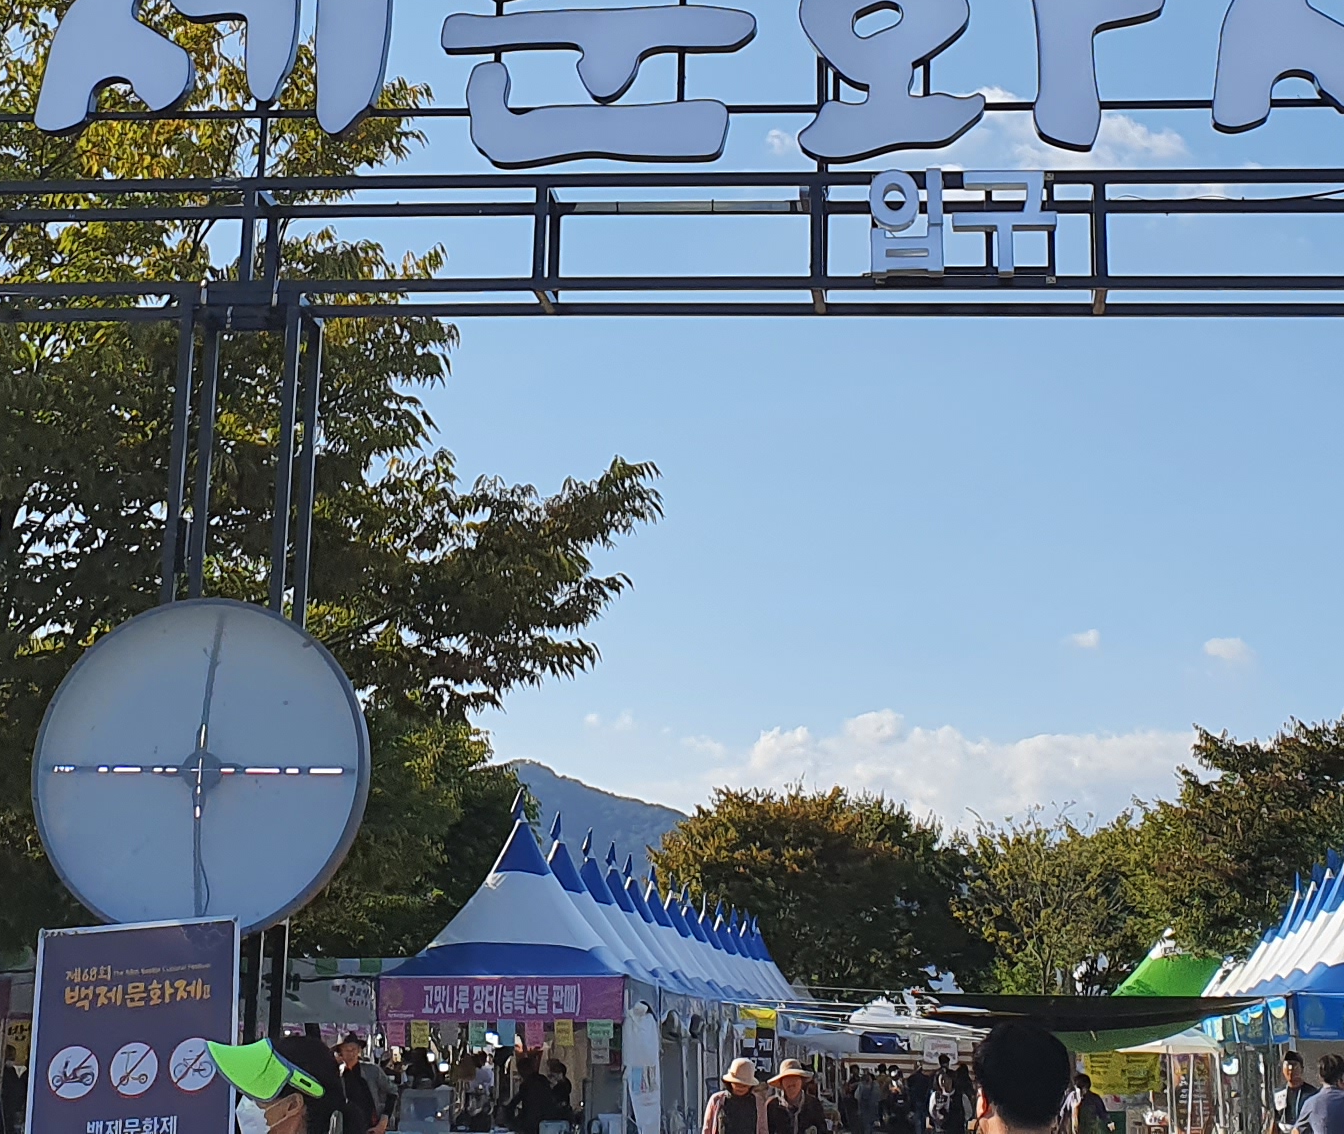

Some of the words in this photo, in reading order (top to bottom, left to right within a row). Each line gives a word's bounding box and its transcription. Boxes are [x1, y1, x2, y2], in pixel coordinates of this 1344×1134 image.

[868, 167, 1058, 280] 입구
[64, 978, 202, 1011] 백제문화제
[422, 984, 469, 1014] 고맛나루
